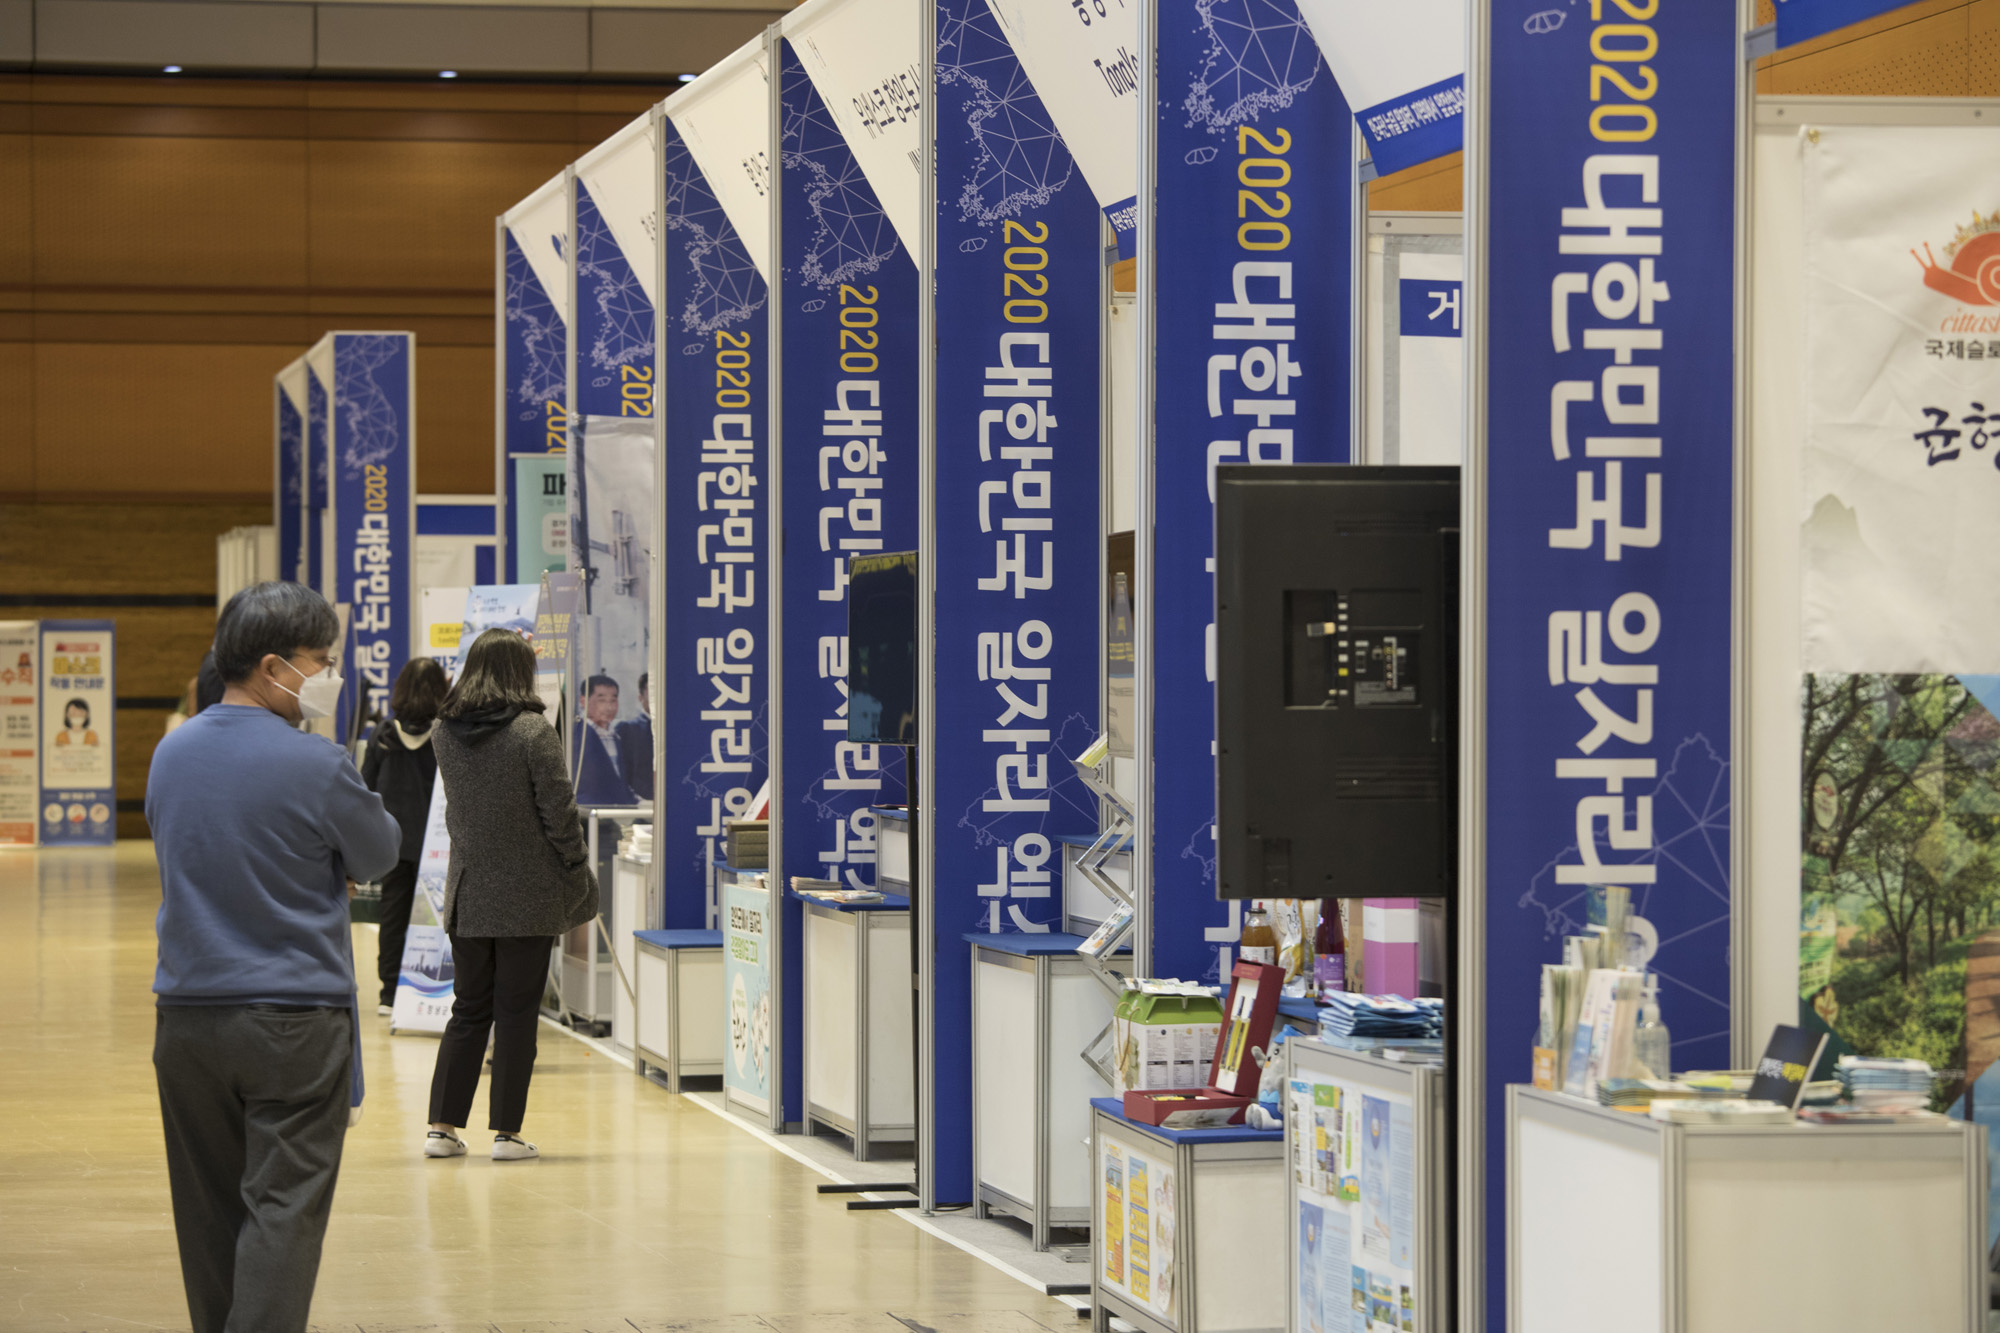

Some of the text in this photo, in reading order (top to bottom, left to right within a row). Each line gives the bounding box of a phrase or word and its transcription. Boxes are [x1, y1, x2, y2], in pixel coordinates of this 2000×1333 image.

[853, 88, 896, 140] 유네스코
[1588, 0, 1659, 143] 2020
[1237, 126, 1292, 251] 2020
[839, 284, 879, 373] 2020
[1003, 220, 1049, 324] 2020
[1427, 288, 1460, 330] 거
[716, 330, 751, 408] 2020
[1548, 154, 1670, 562] 대한민국
[365, 464, 387, 512] 2020
[697, 413, 758, 615] 대한민국
[978, 332, 1057, 600] 대한민국
[354, 513, 391, 634] 대한민국
[696, 628, 754, 774] 일자리
[978, 619, 1052, 812] 일자리
[1548, 593, 1661, 886] 일자리
